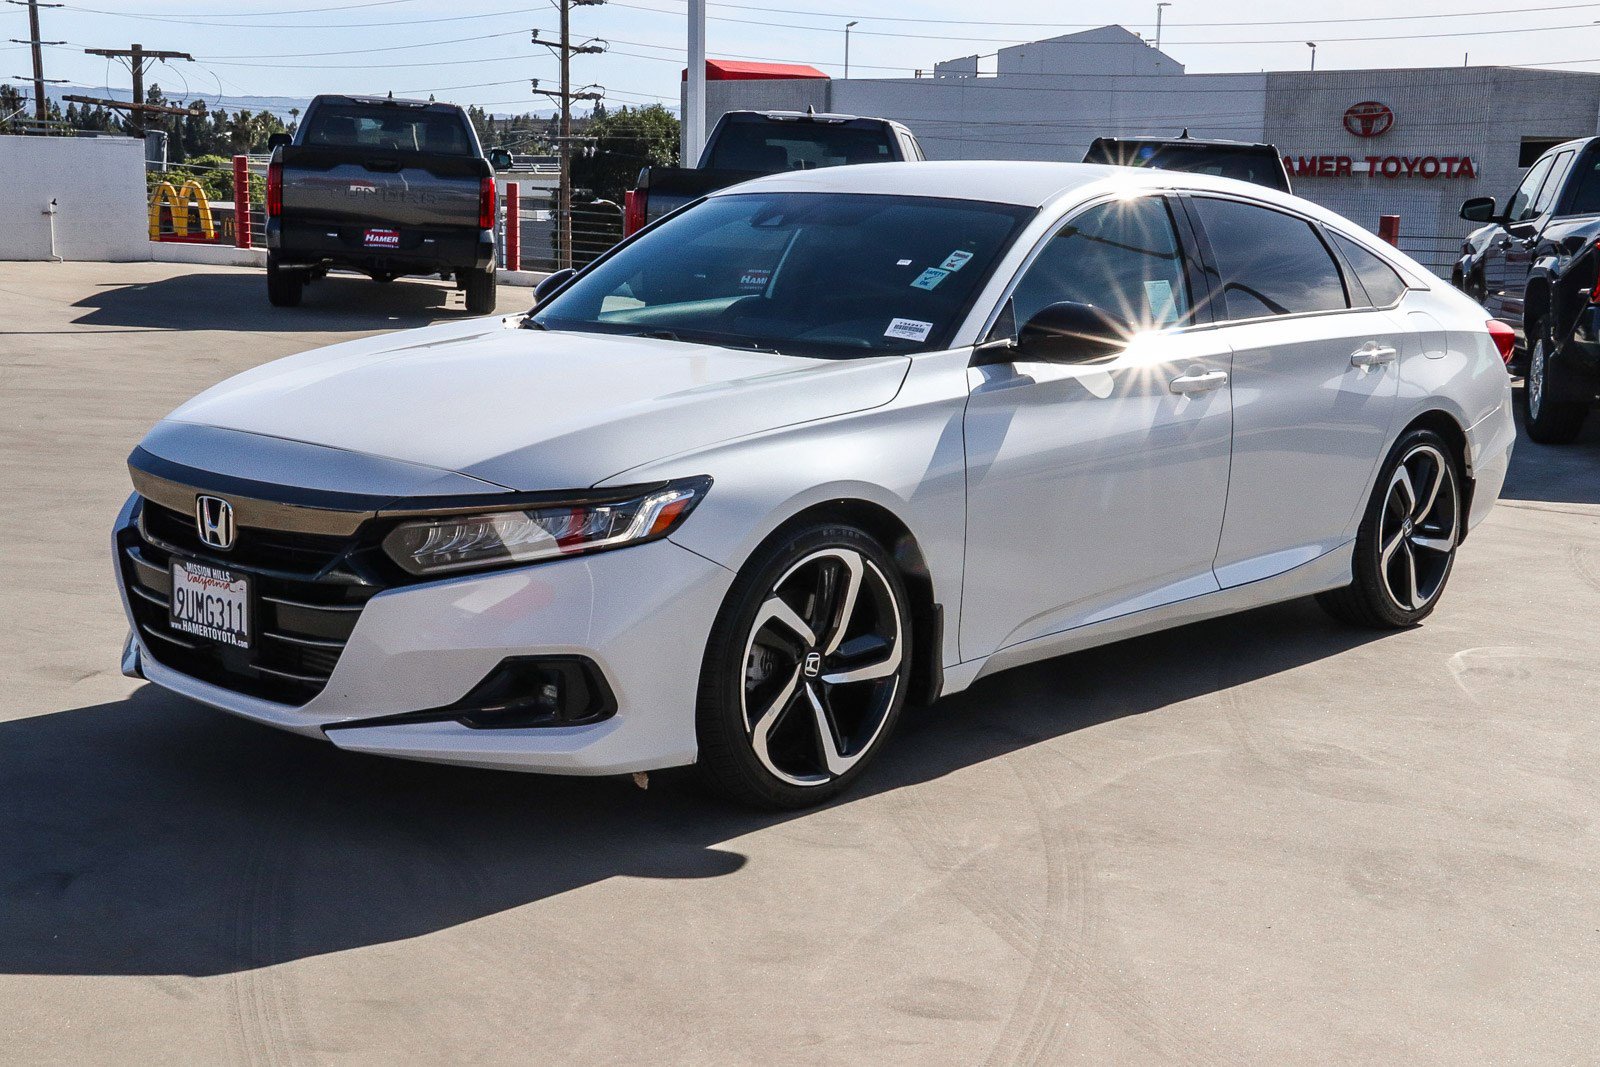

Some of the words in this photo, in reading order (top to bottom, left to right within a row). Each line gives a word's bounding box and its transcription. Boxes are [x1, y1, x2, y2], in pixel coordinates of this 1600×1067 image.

[1365, 156, 1477, 179] TOYOTA
[365, 234, 399, 243] HAMER
[186, 562, 212, 577] MISSION
[212, 567, 231, 582] HILLS
[186, 572, 236, 593] California
[176, 587, 245, 635] 9UMG311
